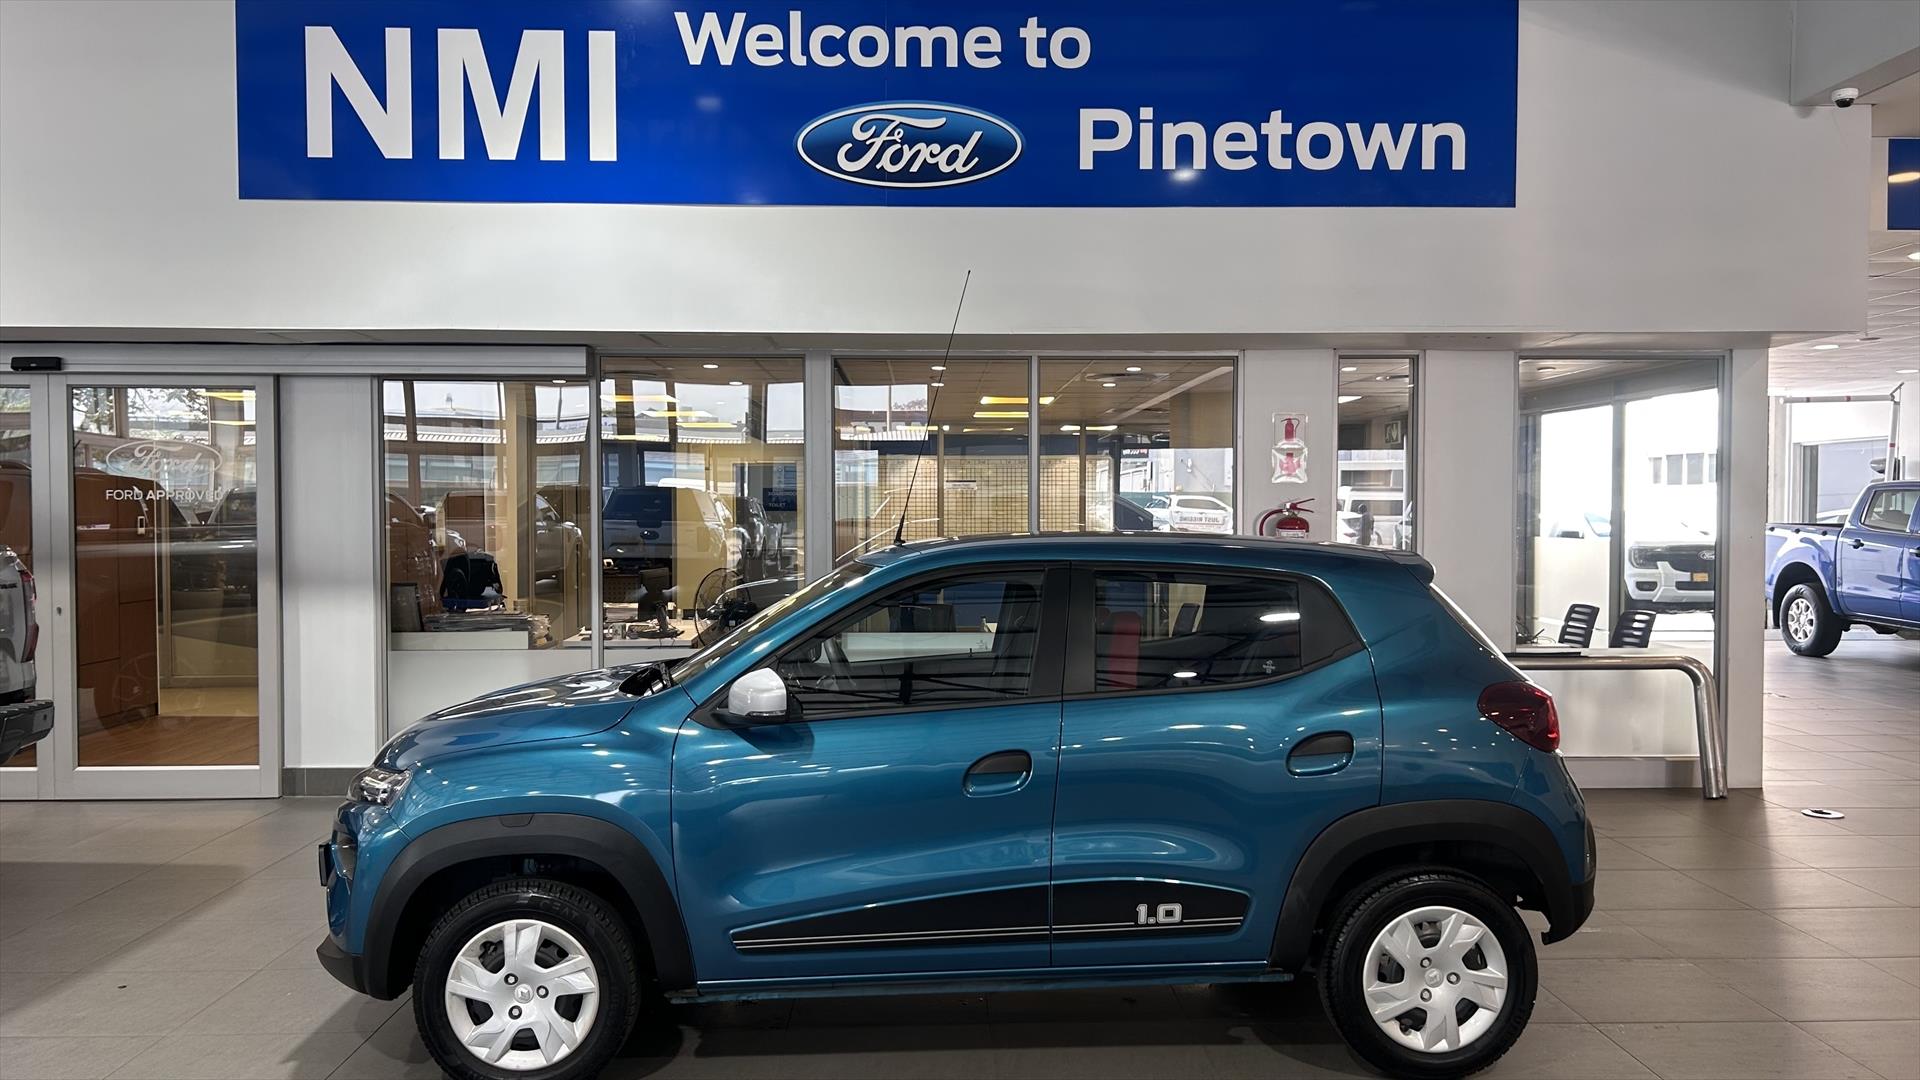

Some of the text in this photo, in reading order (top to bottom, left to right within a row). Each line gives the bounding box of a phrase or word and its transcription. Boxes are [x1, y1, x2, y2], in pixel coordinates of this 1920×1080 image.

[674, 10, 1091, 69] Welcome to
[304, 25, 618, 162] NMI
[836, 113, 984, 175] Ford
[1079, 107, 1467, 171] Pinetown
[127, 443, 206, 474] Ford
[105, 489, 225, 501] FORD APPROVED
[1136, 903, 1182, 925] 1.0
